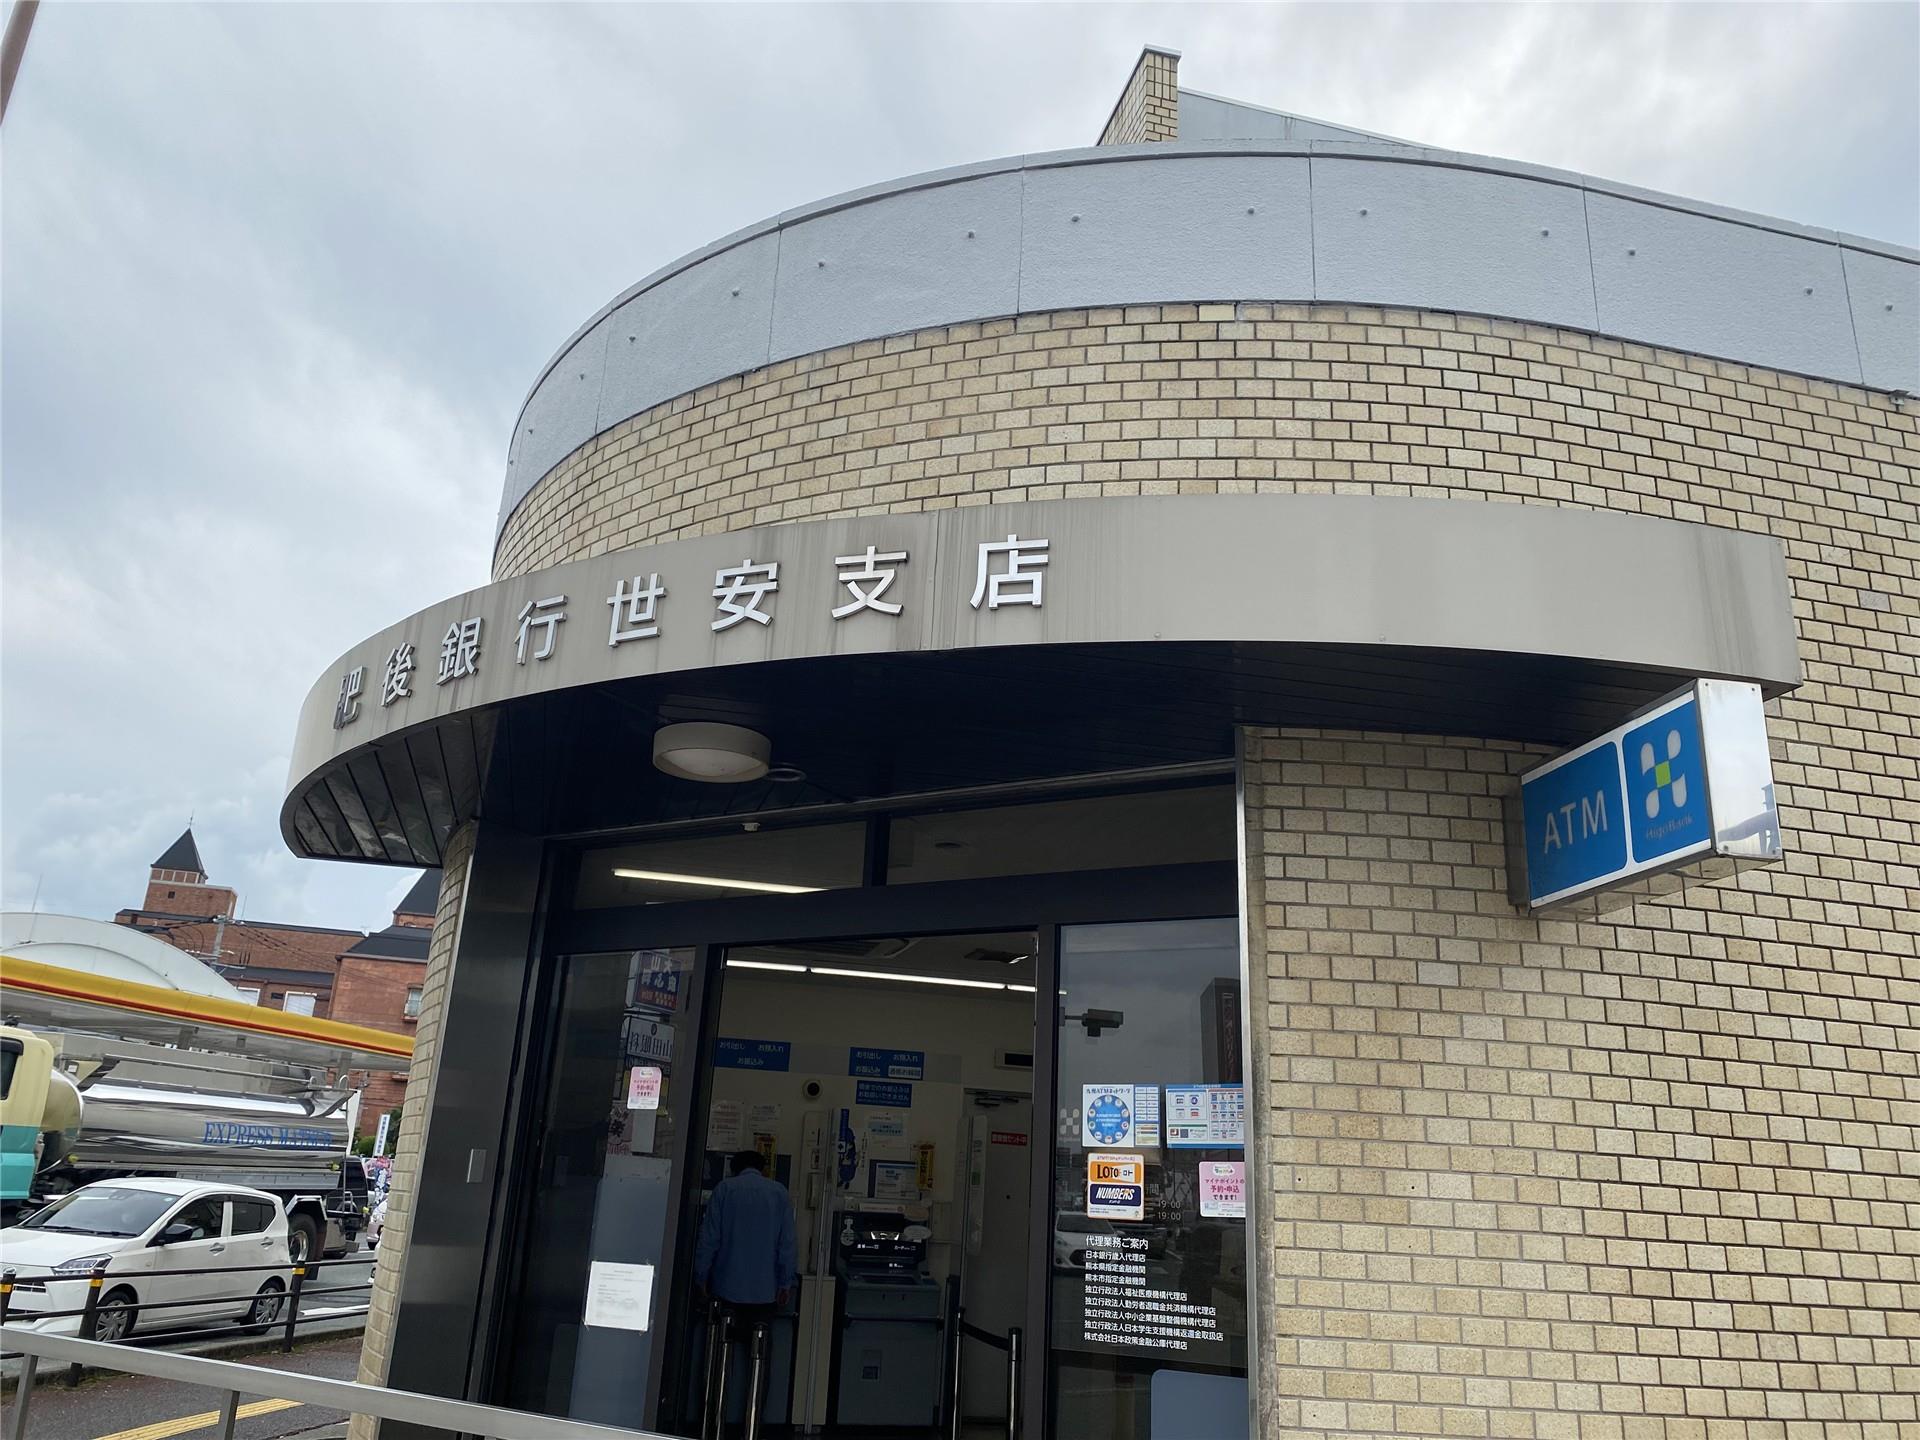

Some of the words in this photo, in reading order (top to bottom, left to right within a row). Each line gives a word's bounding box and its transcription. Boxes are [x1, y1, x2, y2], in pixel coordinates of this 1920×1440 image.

[332, 534, 1050, 730] 肥後銀行世安支店
[1544, 790, 1608, 854] ATM
[202, 1121, 273, 1145] EXPRESS
[1097, 1164, 1119, 1179] LOTO
[1096, 1187, 1135, 1201] NUMBERS
[1085, 1235, 1149, 1250] 代理業務ご案内
[1085, 1262, 1146, 1274] 熊本県指定金融機関
[1085, 1274, 1146, 1286] 熊本市指定金融機関
